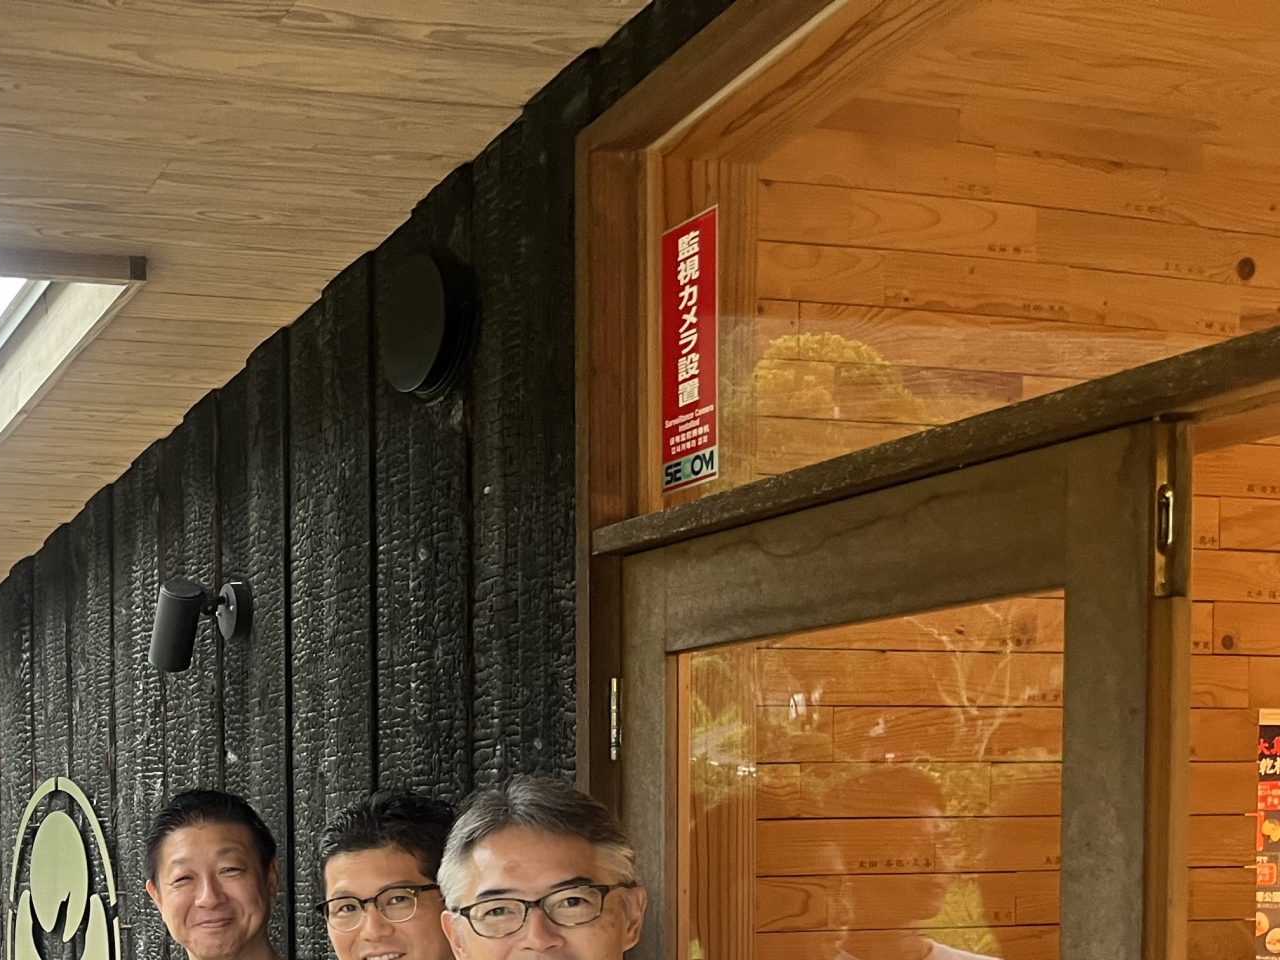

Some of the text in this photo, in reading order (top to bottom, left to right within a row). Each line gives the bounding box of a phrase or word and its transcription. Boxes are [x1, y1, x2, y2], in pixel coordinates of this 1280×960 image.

[677, 230, 700, 408] 監視カメラ設置
[665, 450, 714, 486] SECOM
